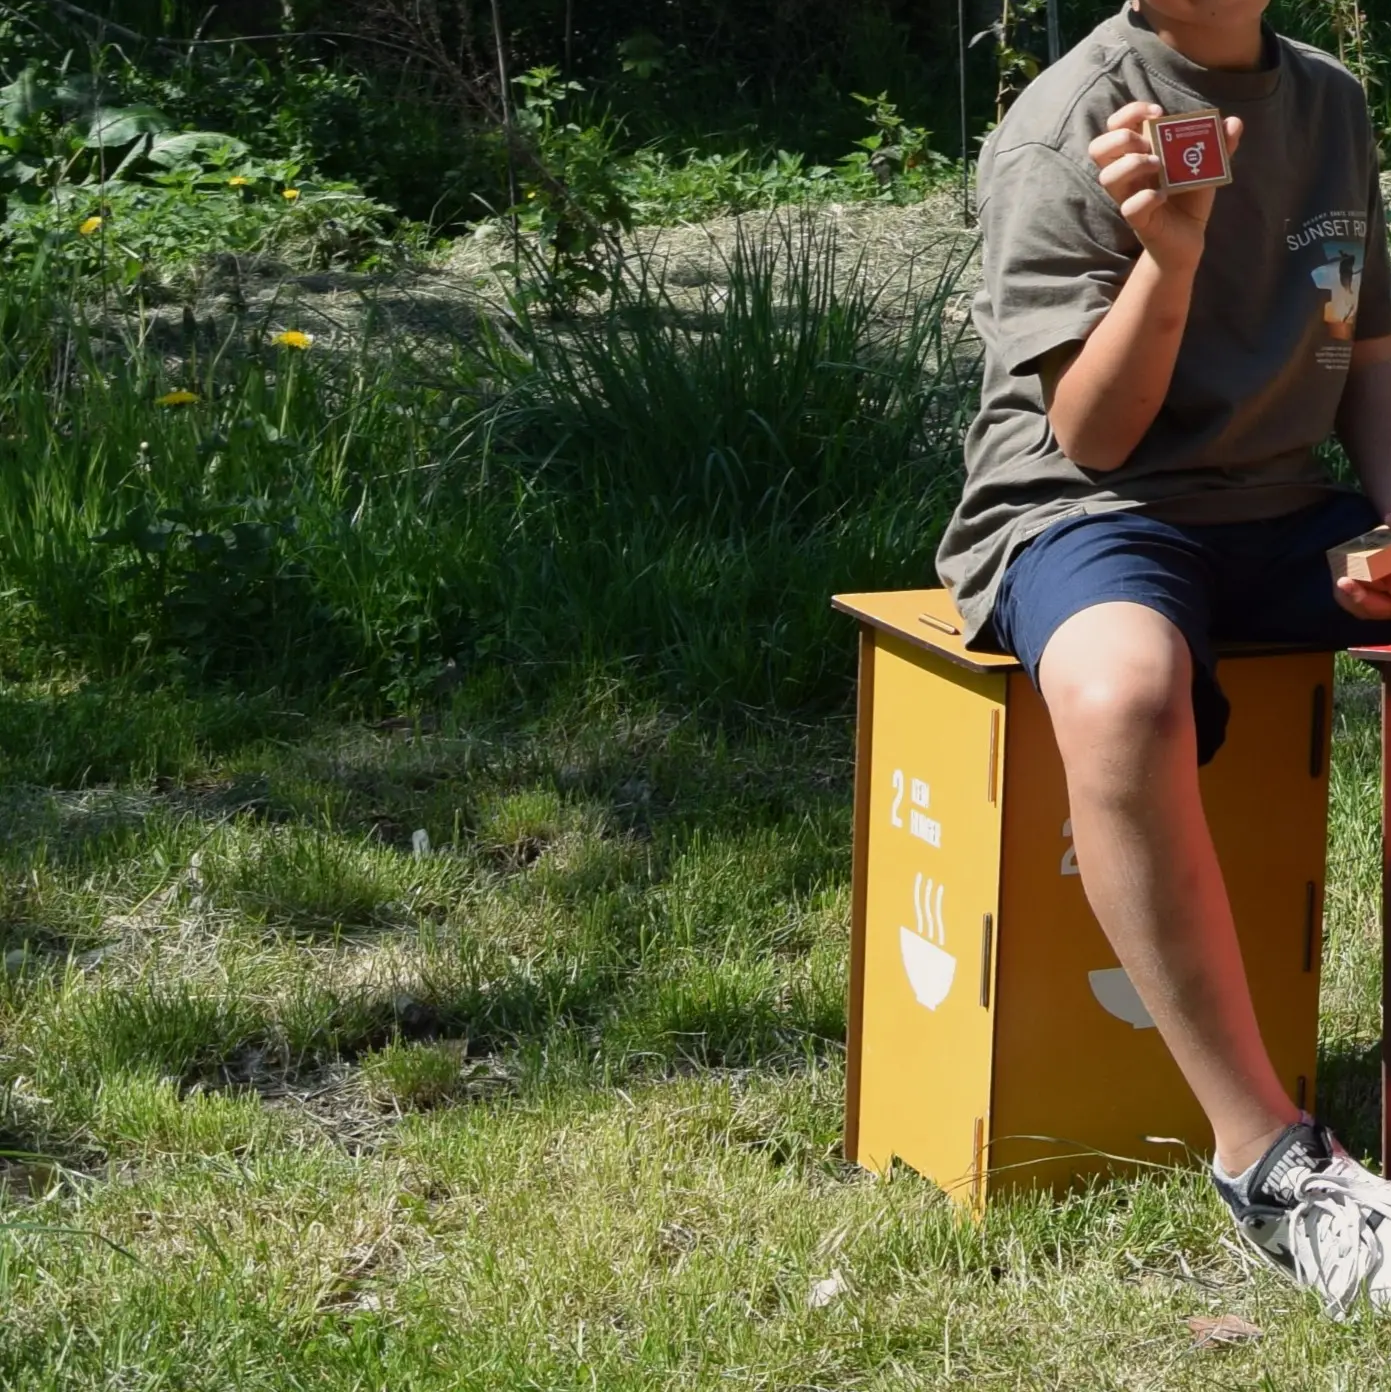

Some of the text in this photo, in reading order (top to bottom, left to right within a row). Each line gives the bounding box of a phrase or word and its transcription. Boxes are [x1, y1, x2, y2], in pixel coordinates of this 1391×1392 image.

[1164, 128, 1173, 142] 5
[1286, 219, 1350, 251] SUNSET
[891, 769, 905, 829] 2
